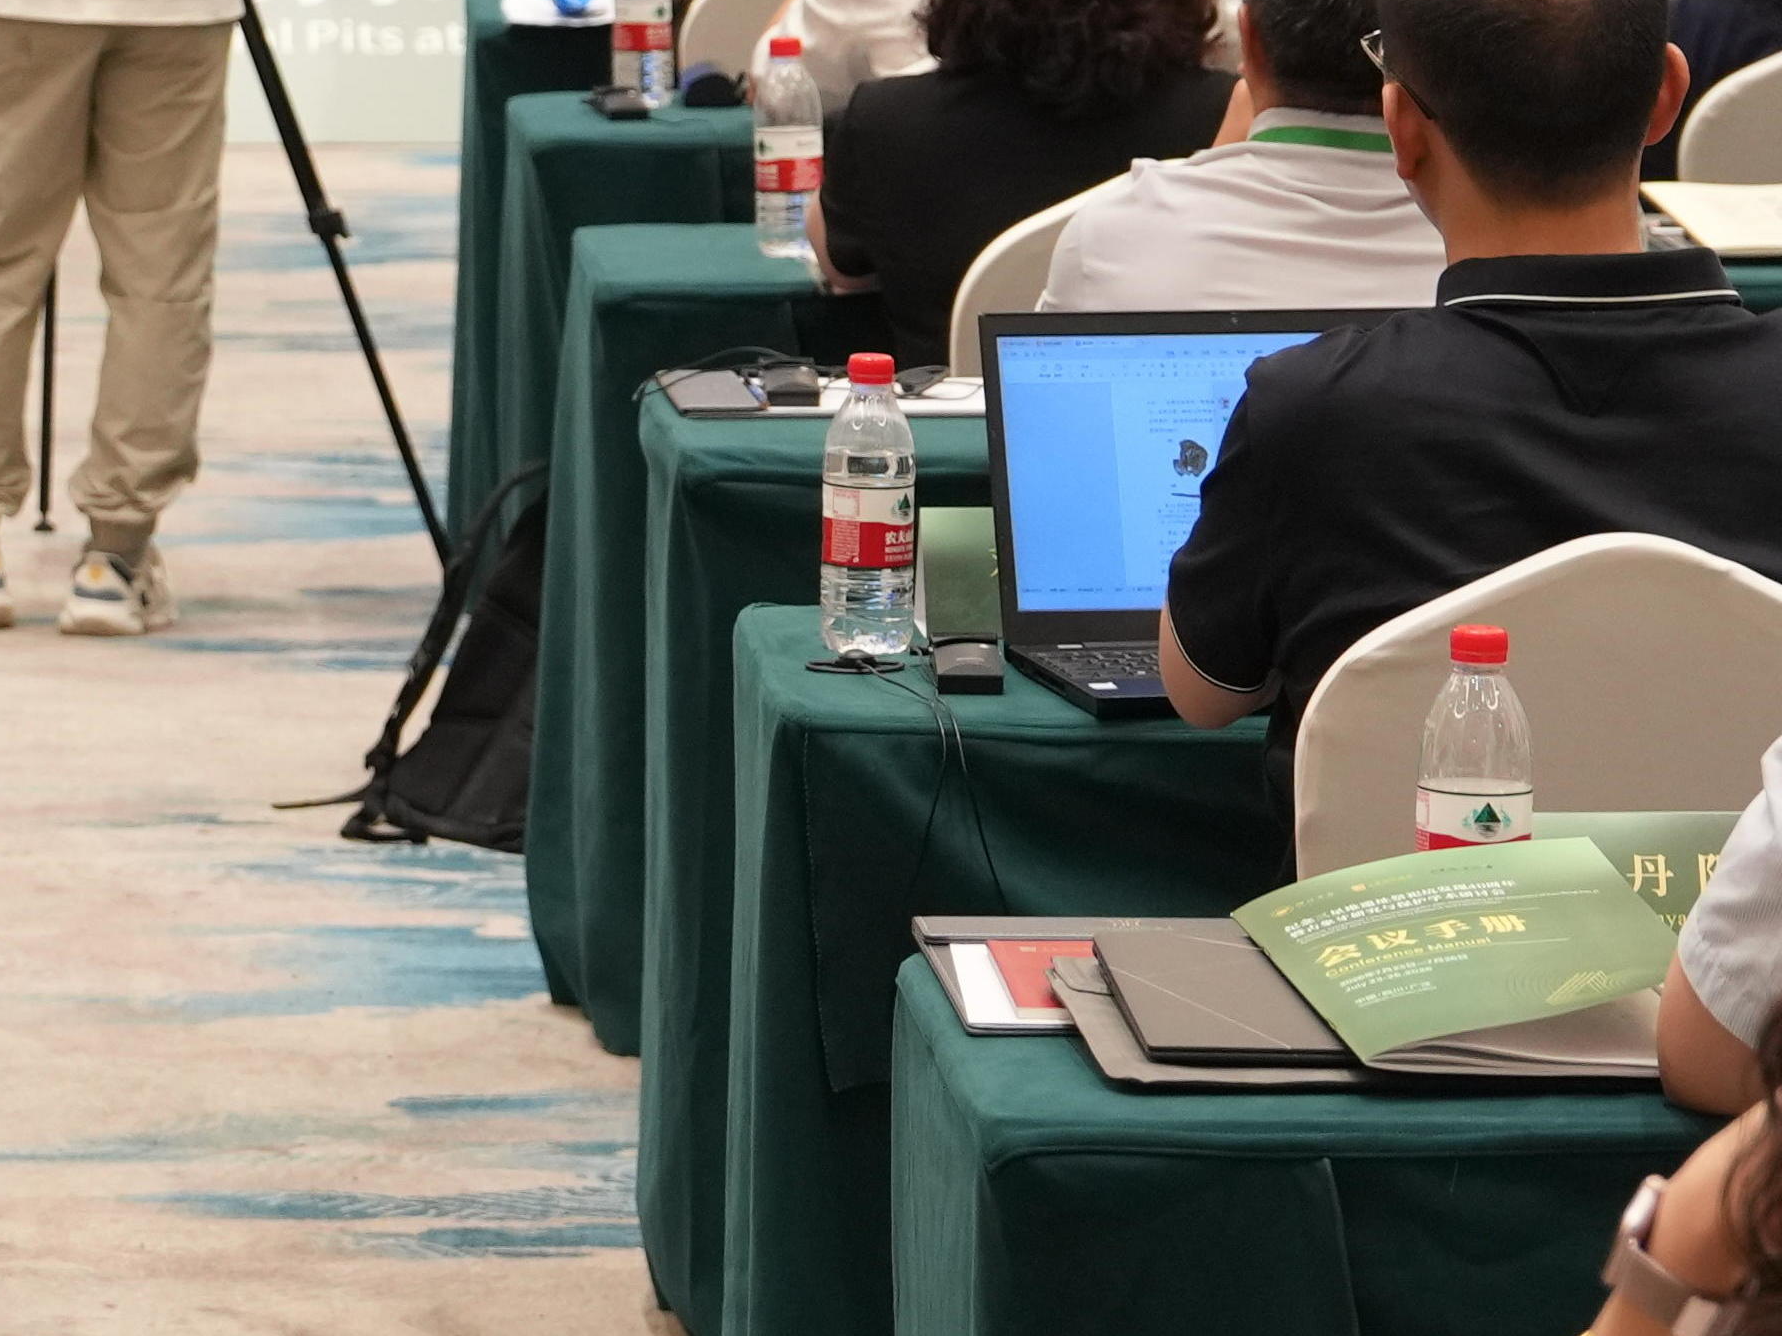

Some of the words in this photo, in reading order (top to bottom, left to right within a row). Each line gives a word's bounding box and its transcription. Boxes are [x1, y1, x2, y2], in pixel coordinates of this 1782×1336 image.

[306, 17, 406, 57] Pits
[1314, 913, 1528, 968] 会议手册
[1325, 946, 1425, 978] Conference
[1427, 936, 1492, 952] Manual
